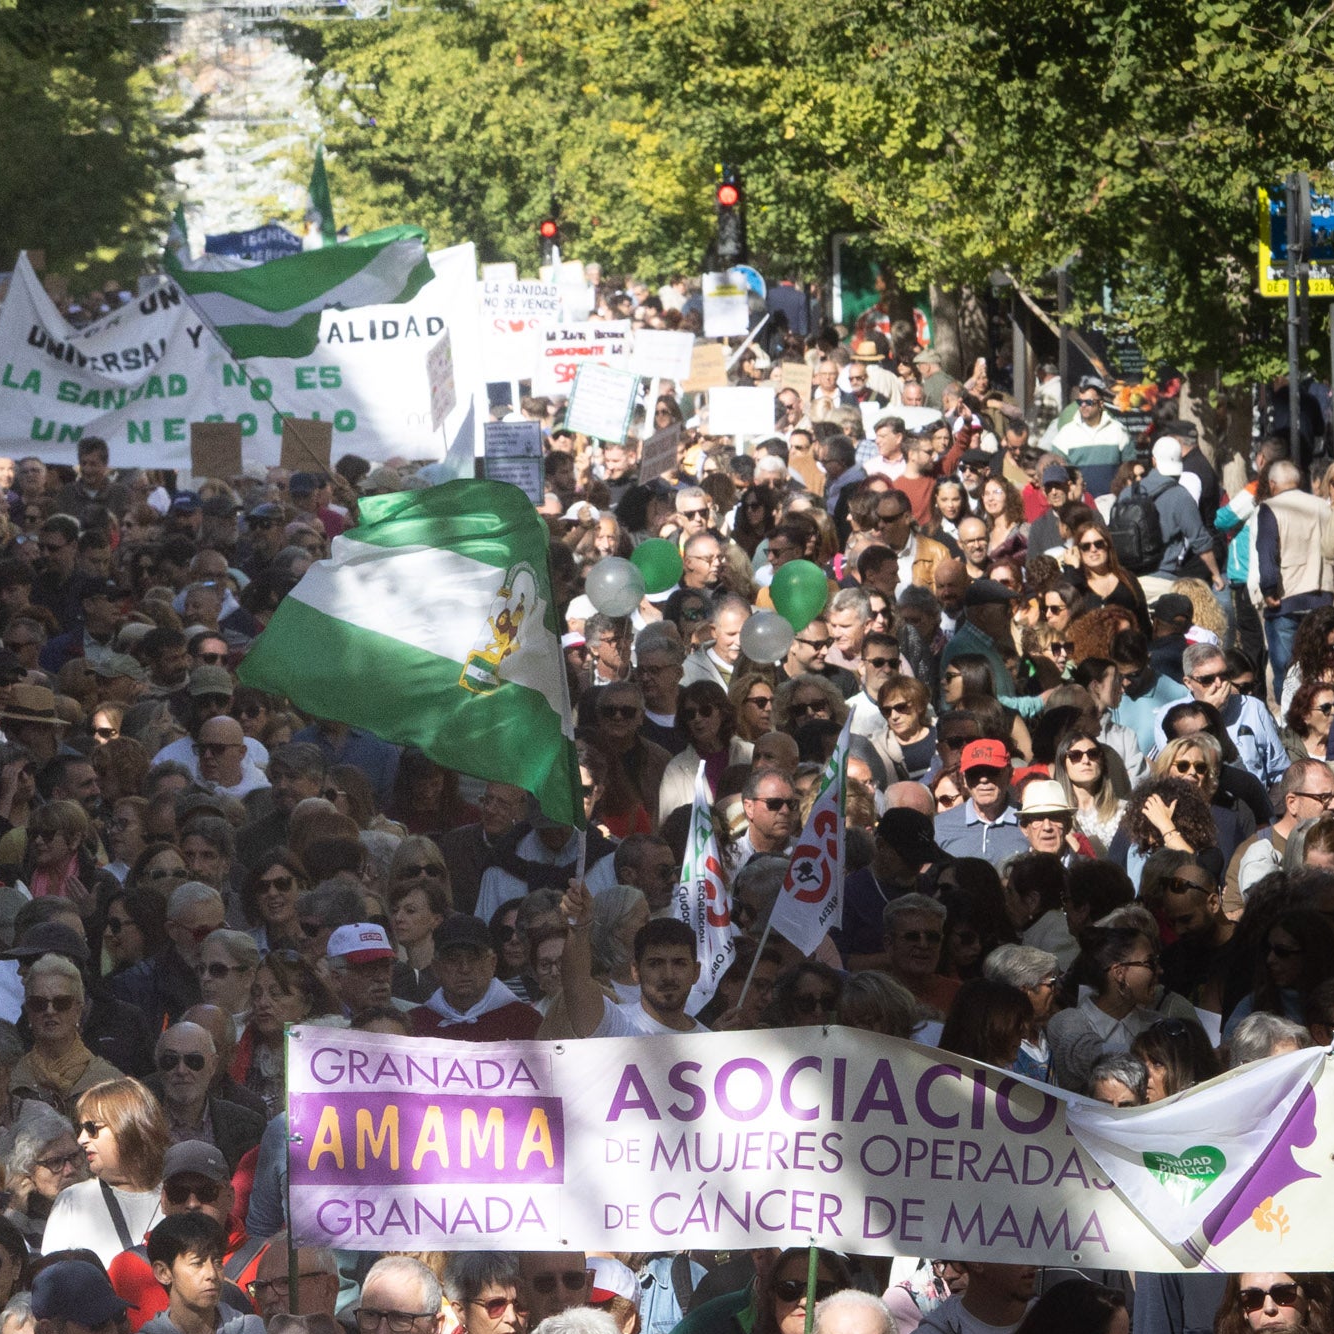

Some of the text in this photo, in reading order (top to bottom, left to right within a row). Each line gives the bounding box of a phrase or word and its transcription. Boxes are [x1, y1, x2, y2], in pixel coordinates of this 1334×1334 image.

[1, 363, 43, 394] LA
[295, 366, 342, 390] ES
[309, 1046, 543, 1092] GRANADA
[308, 1104, 556, 1171] AMAMA
[604, 1137, 642, 1165] DE
[649, 1127, 845, 1175] MUJERES
[316, 1197, 549, 1239] GRANADA
[604, 1184, 1110, 1254] DE CÁNCER DE MAMA
